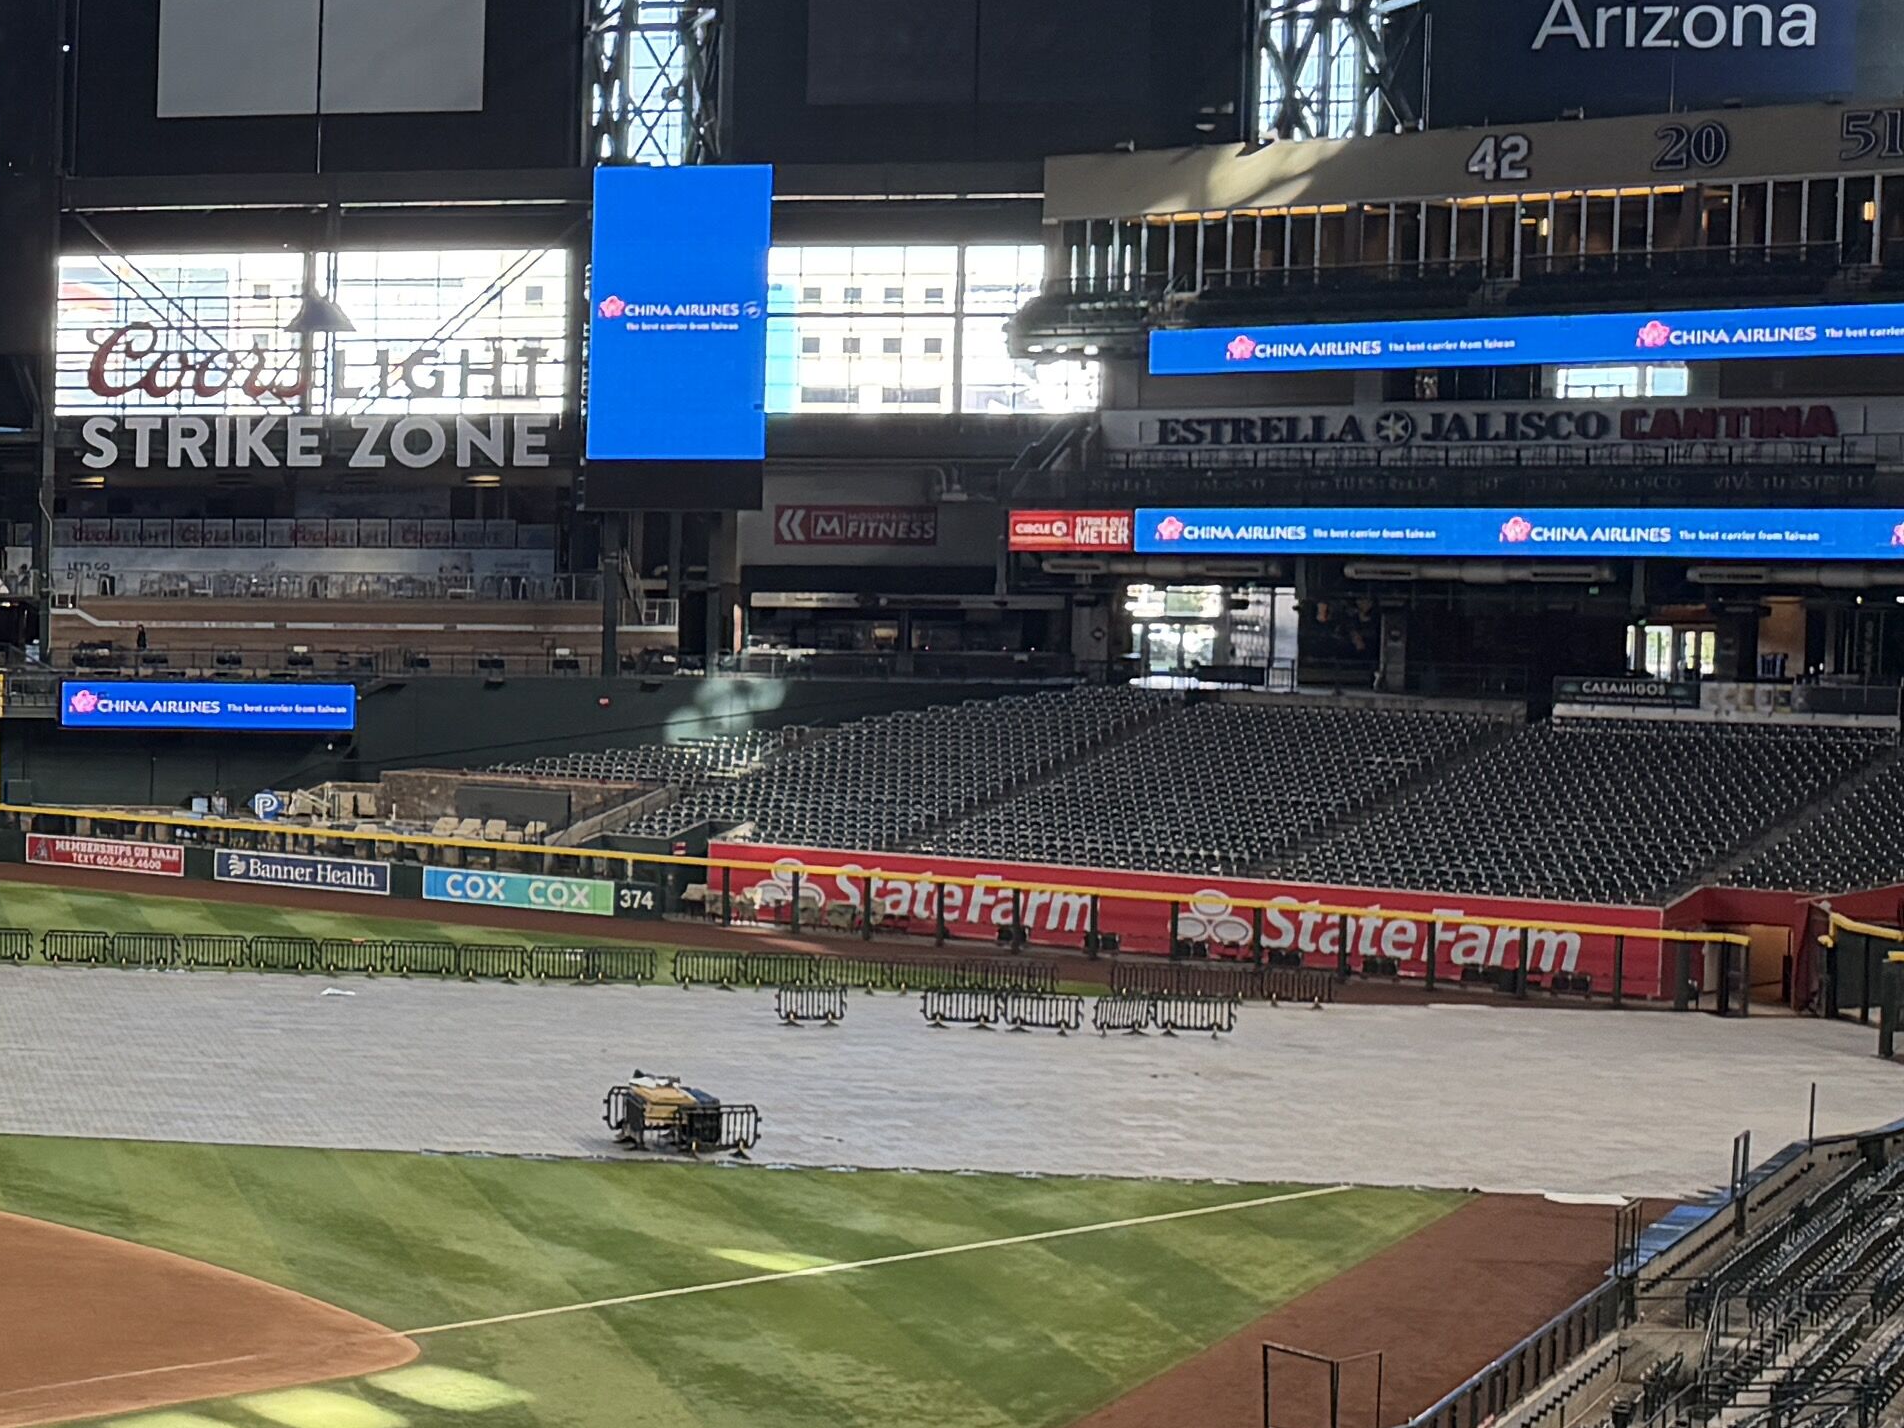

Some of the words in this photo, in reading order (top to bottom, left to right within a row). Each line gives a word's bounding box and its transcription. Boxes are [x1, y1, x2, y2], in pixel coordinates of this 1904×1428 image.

[1652, 122, 1730, 172] 20
[1838, 109, 1904, 160] 51
[1466, 133, 1532, 183] 42
[1668, 328, 1729, 346] CHINA
[1731, 325, 1817, 344] AIRLINES
[87, 321, 310, 400] Coors
[333, 345, 549, 401] LIGHT
[1157, 415, 1366, 445] ESTRELLA
[1421, 410, 1611, 443] JALISCO
[1620, 405, 1838, 441] CANTINA
[80, 414, 323, 470] STRIKE
[346, 413, 551, 470] ZONE
[847, 521, 936, 539] FITNESS
[1074, 525, 1129, 544] METER
[1581, 680, 1666, 697] CASAMIGOS
[55, 839, 132, 857] MEMBERSHIPS
[134, 846, 149, 858] ON
[152, 848, 180, 861] SALE
[72, 853, 95, 864] TEXT
[249, 858, 314, 883] Banner
[316, 863, 377, 888] Health
[445, 874, 507, 901] COX
[528, 879, 591, 909] COX
[619, 889, 654, 911] 374
[835, 863, 958, 923] State
[964, 874, 1092, 932] Farm
[1261, 895, 1418, 960] State
[1420, 908, 1582, 973] Farm
